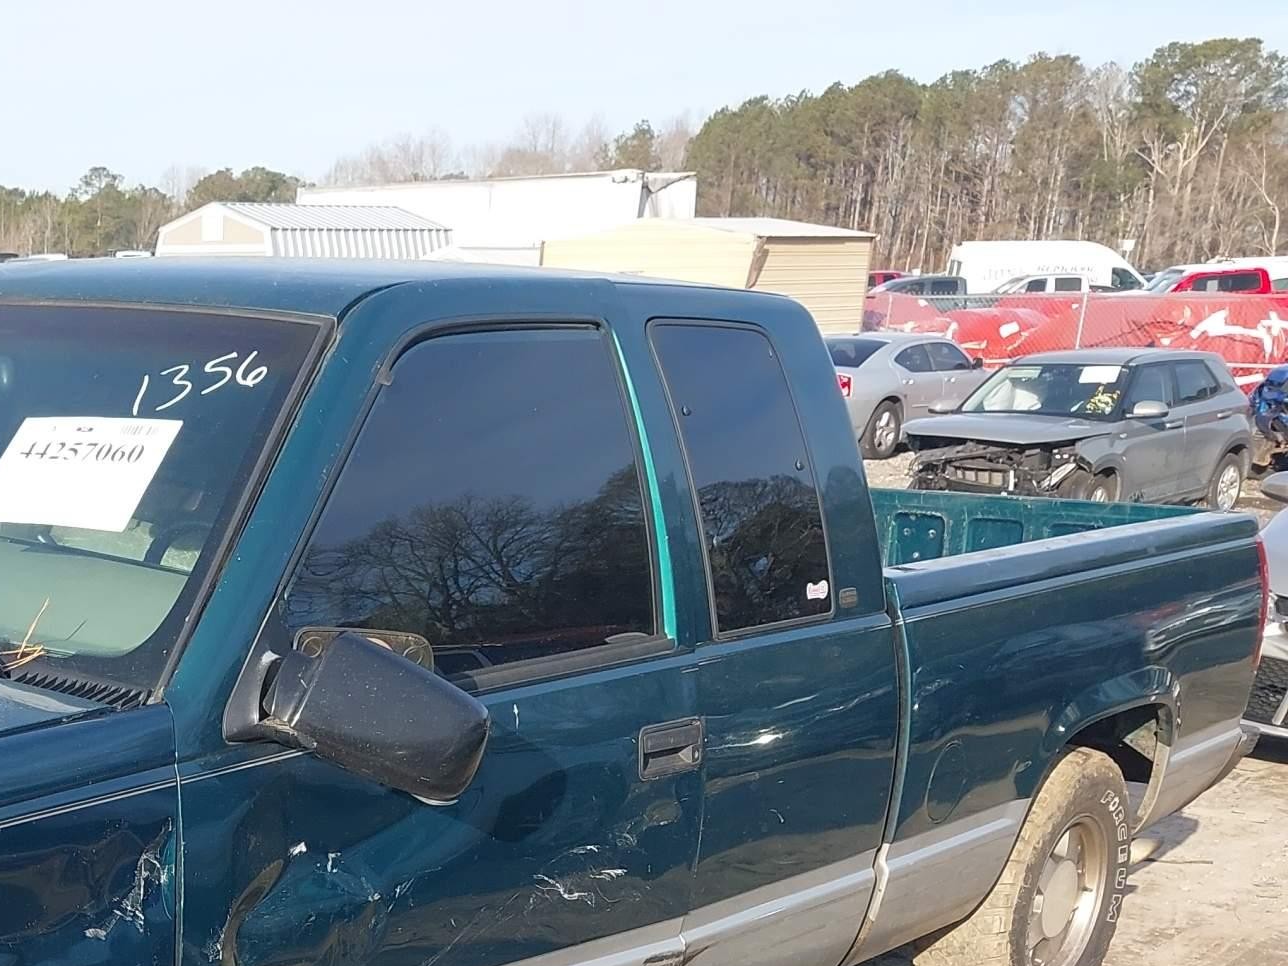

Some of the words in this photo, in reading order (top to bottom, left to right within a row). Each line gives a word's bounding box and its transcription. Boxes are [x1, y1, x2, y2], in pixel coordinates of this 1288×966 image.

[132, 350, 268, 417] 1356
[20, 440, 144, 464] 44257060
[1100, 790, 1128, 922] FORCEUM
